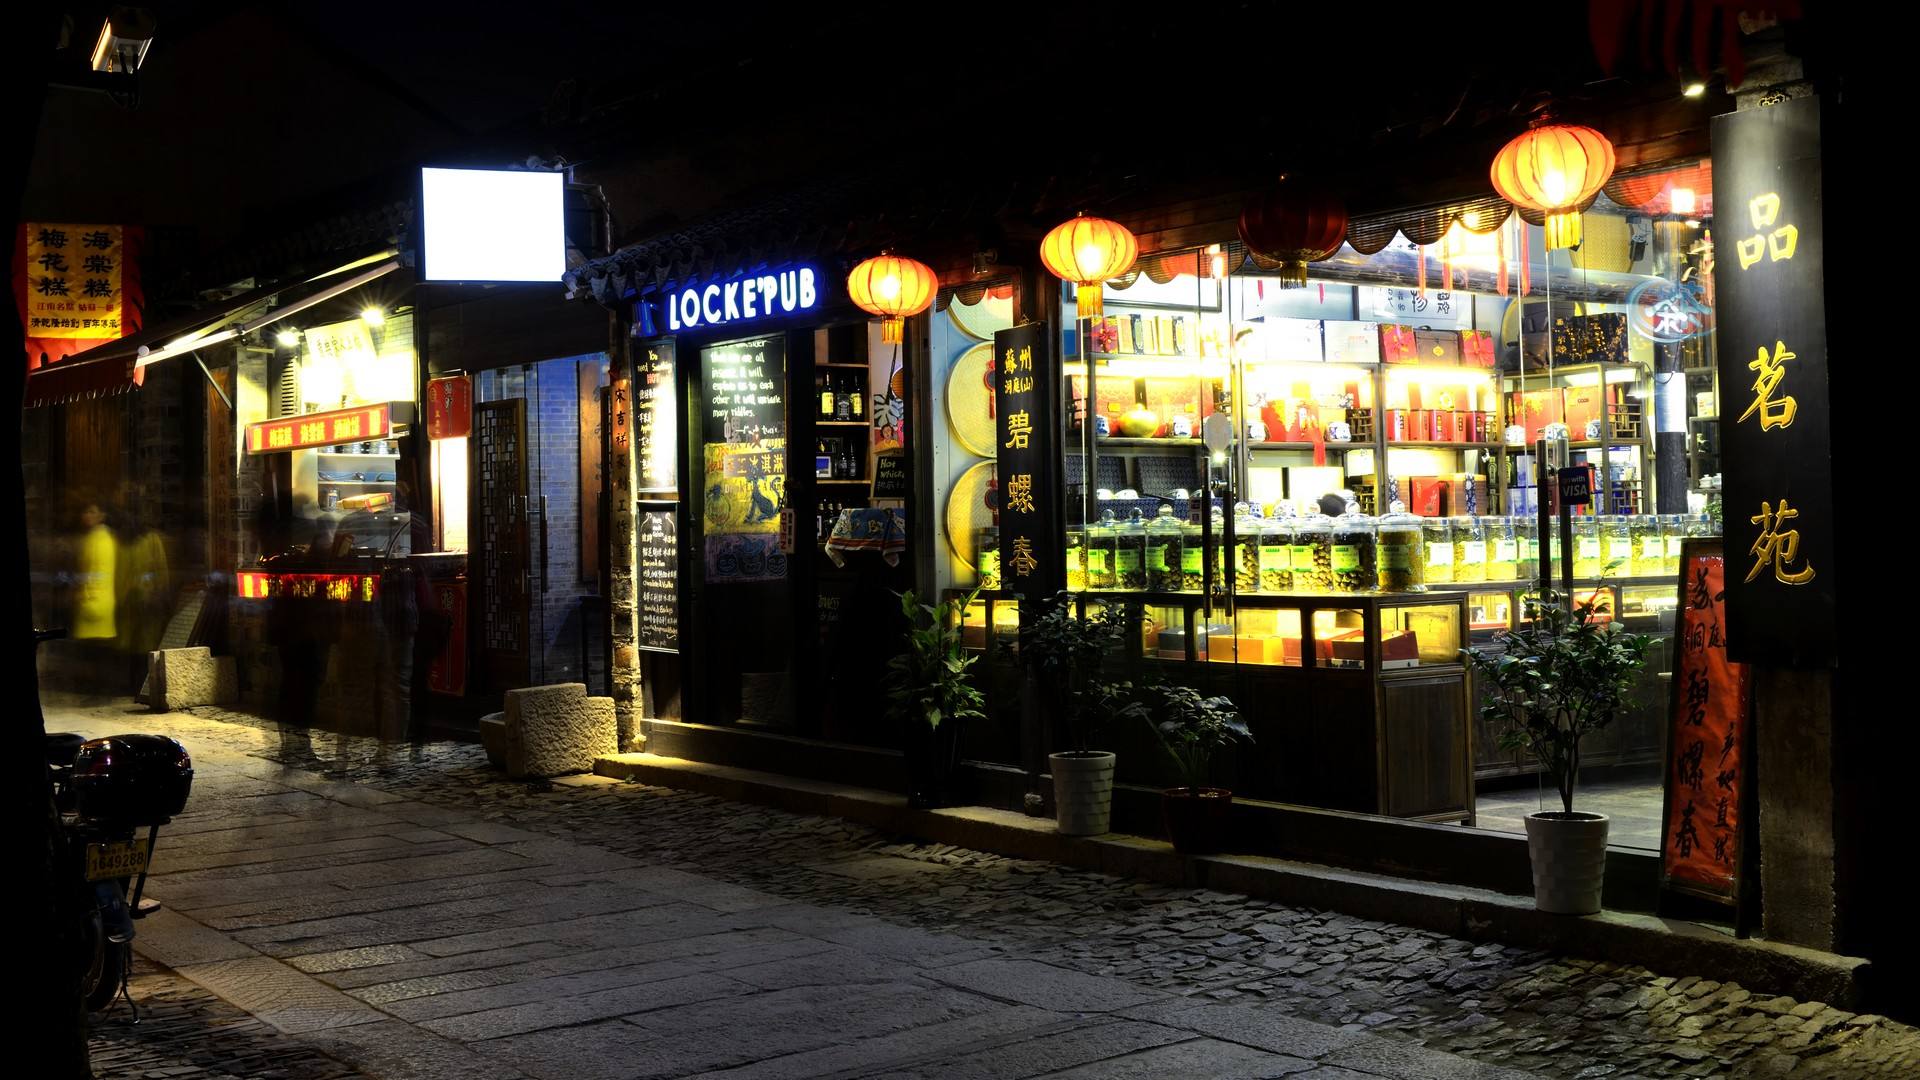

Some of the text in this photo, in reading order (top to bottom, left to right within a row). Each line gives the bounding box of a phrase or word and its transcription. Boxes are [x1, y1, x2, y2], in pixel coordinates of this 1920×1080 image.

[38, 229, 69, 297] 梅花糕
[82, 231, 114, 298] 海棠糕
[748, 366, 763, 378] will
[755, 352, 765, 363] all
[1004, 346, 1032, 375] 蘇州
[760, 379, 774, 390] each
[1737, 192, 1816, 585] 品茗苑
[712, 409, 729, 421] many
[1005, 409, 1037, 577] 碧螺春
[1562, 484, 1588, 497] VISA
[1684, 619, 1727, 656] 洞庭
[1675, 668, 1710, 860] 碧螺春
